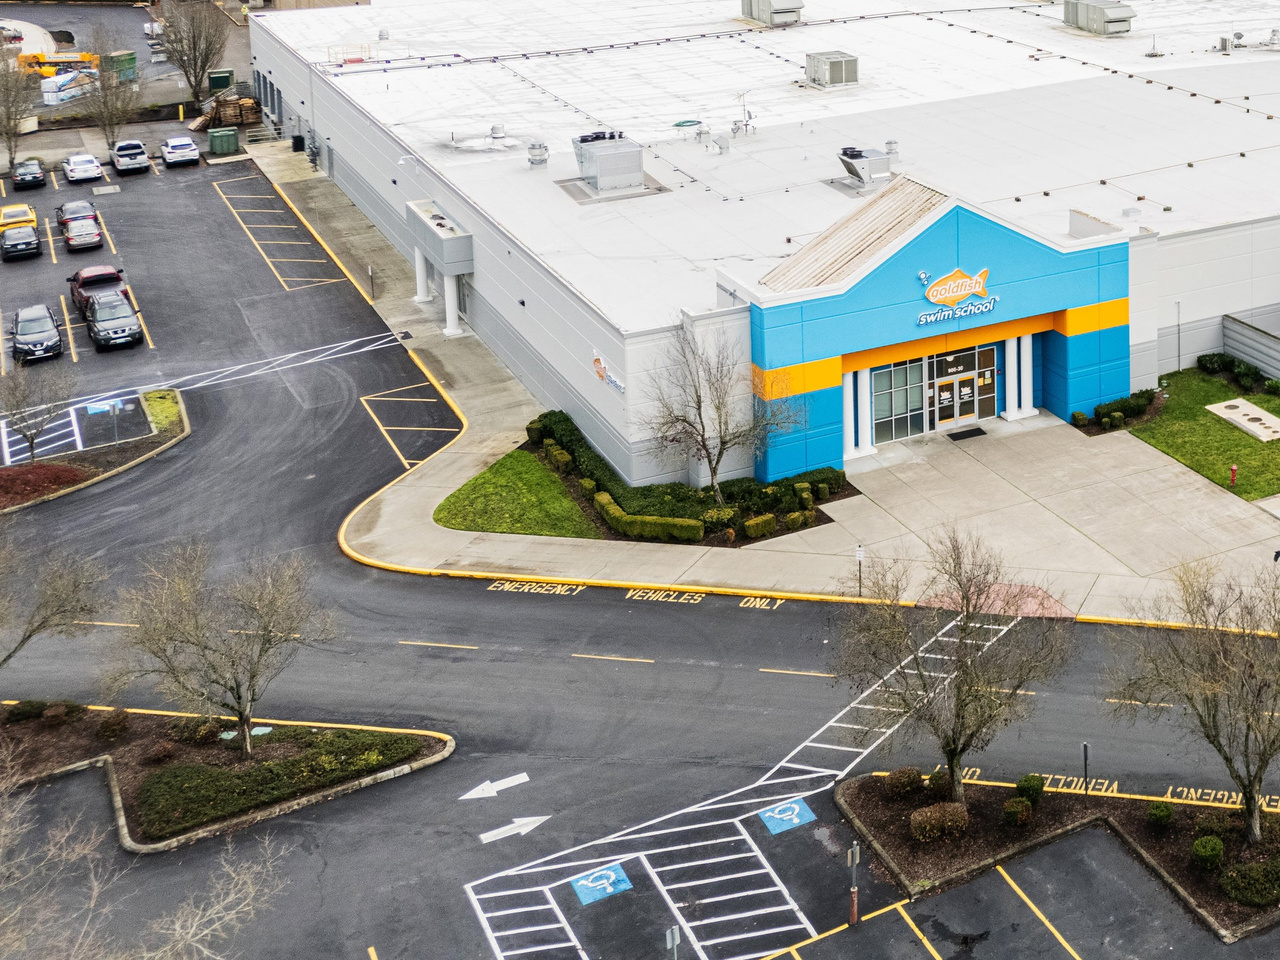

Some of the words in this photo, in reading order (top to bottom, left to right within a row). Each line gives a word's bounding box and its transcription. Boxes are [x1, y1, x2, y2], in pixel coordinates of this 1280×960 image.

[931, 278, 982, 300] goldfish
[919, 309, 952, 325] swim
[487, 580, 587, 596] EMERGENCY
[624, 589, 706, 604] VEHICLES
[739, 596, 786, 610] ONLY
